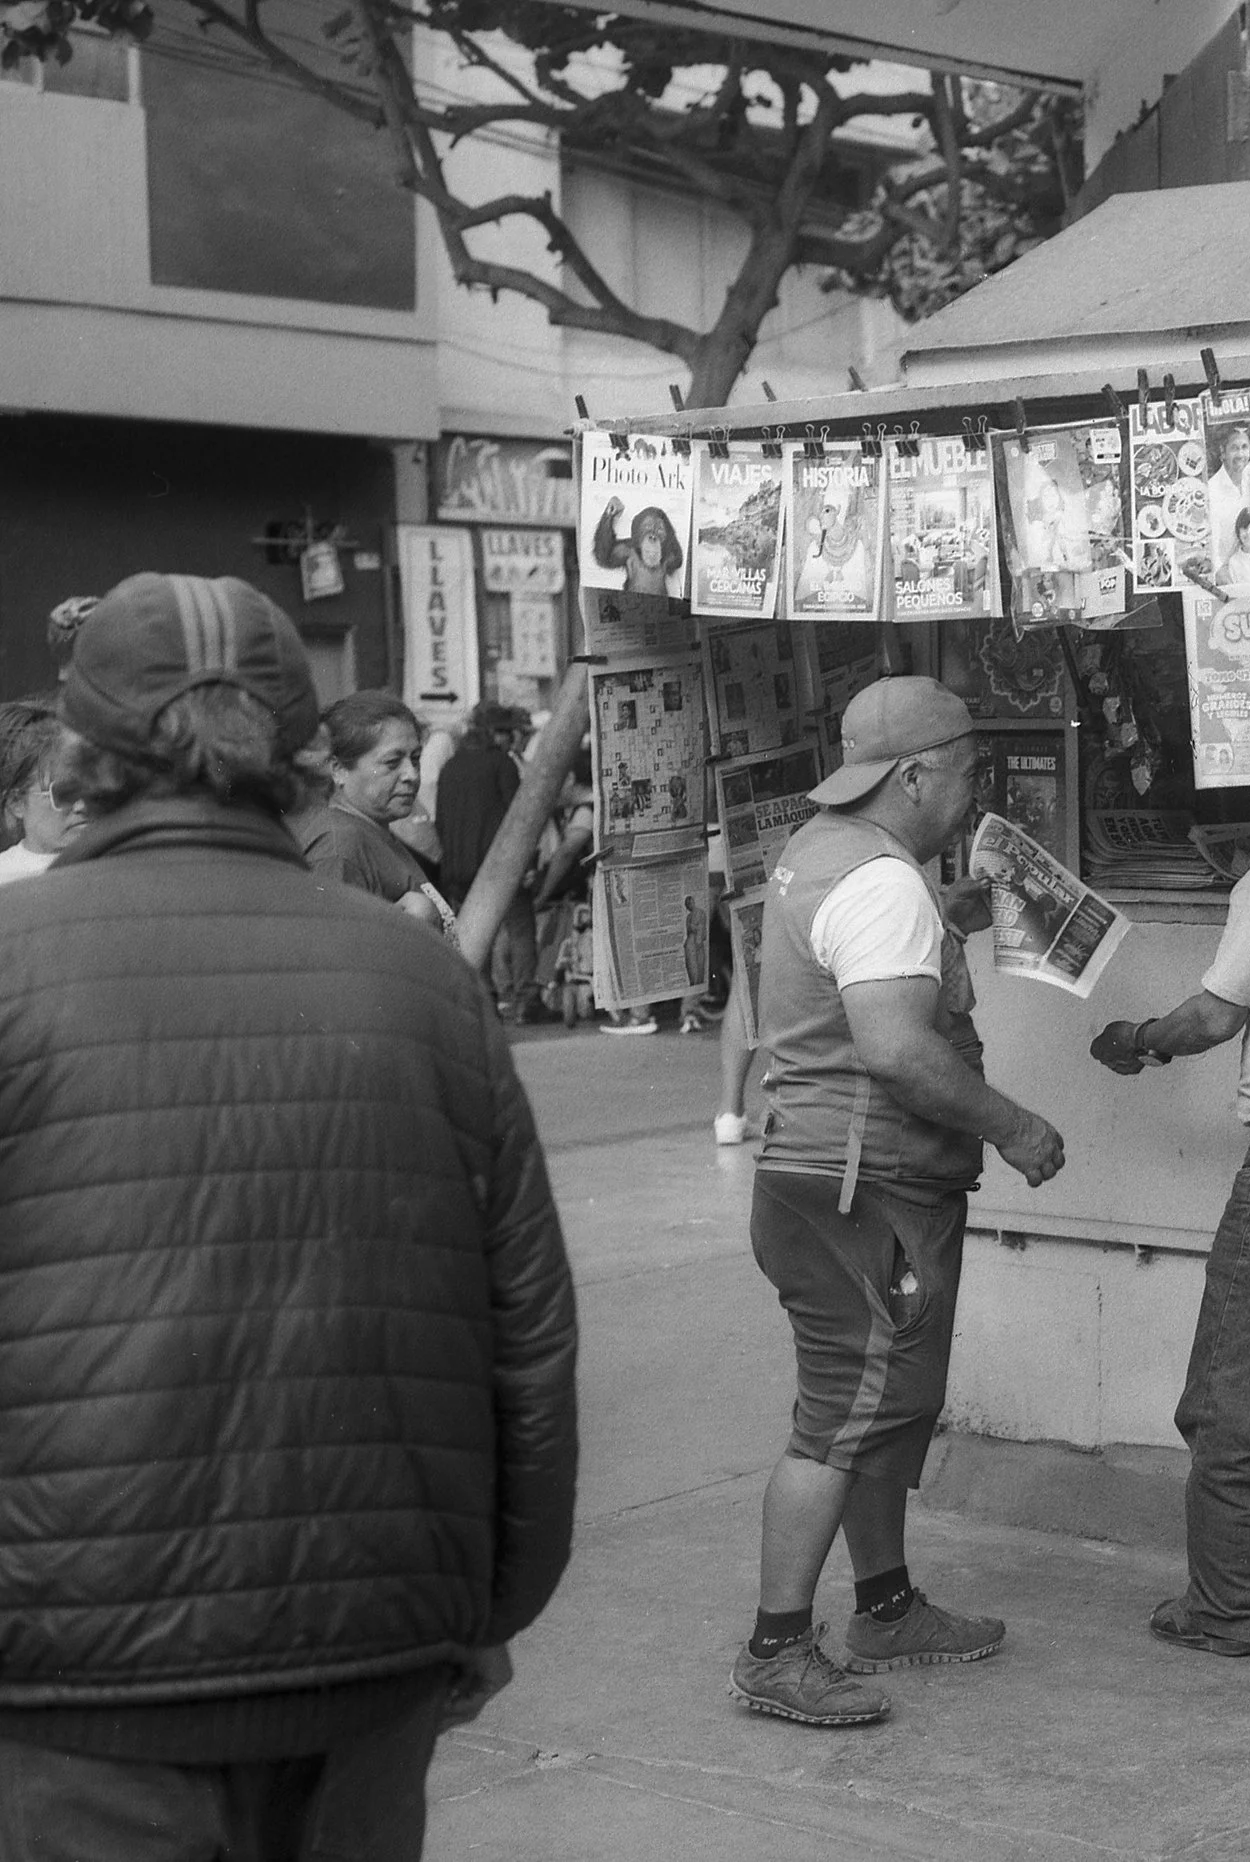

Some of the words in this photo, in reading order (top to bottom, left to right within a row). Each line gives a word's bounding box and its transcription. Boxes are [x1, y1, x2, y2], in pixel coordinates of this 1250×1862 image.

[917, 440, 988, 476] MUEBLE
[593, 455, 648, 485] Photo
[658, 463, 686, 490] Ark
[711, 463, 773, 485] VIAJES
[803, 466, 871, 488] HISTORIA
[488, 532, 556, 557] LLAVES
[710, 579, 762, 595] CERCANAS
[427, 540, 449, 687] LLAVES
[755, 804, 771, 819] SE
[758, 818, 773, 831] LA
